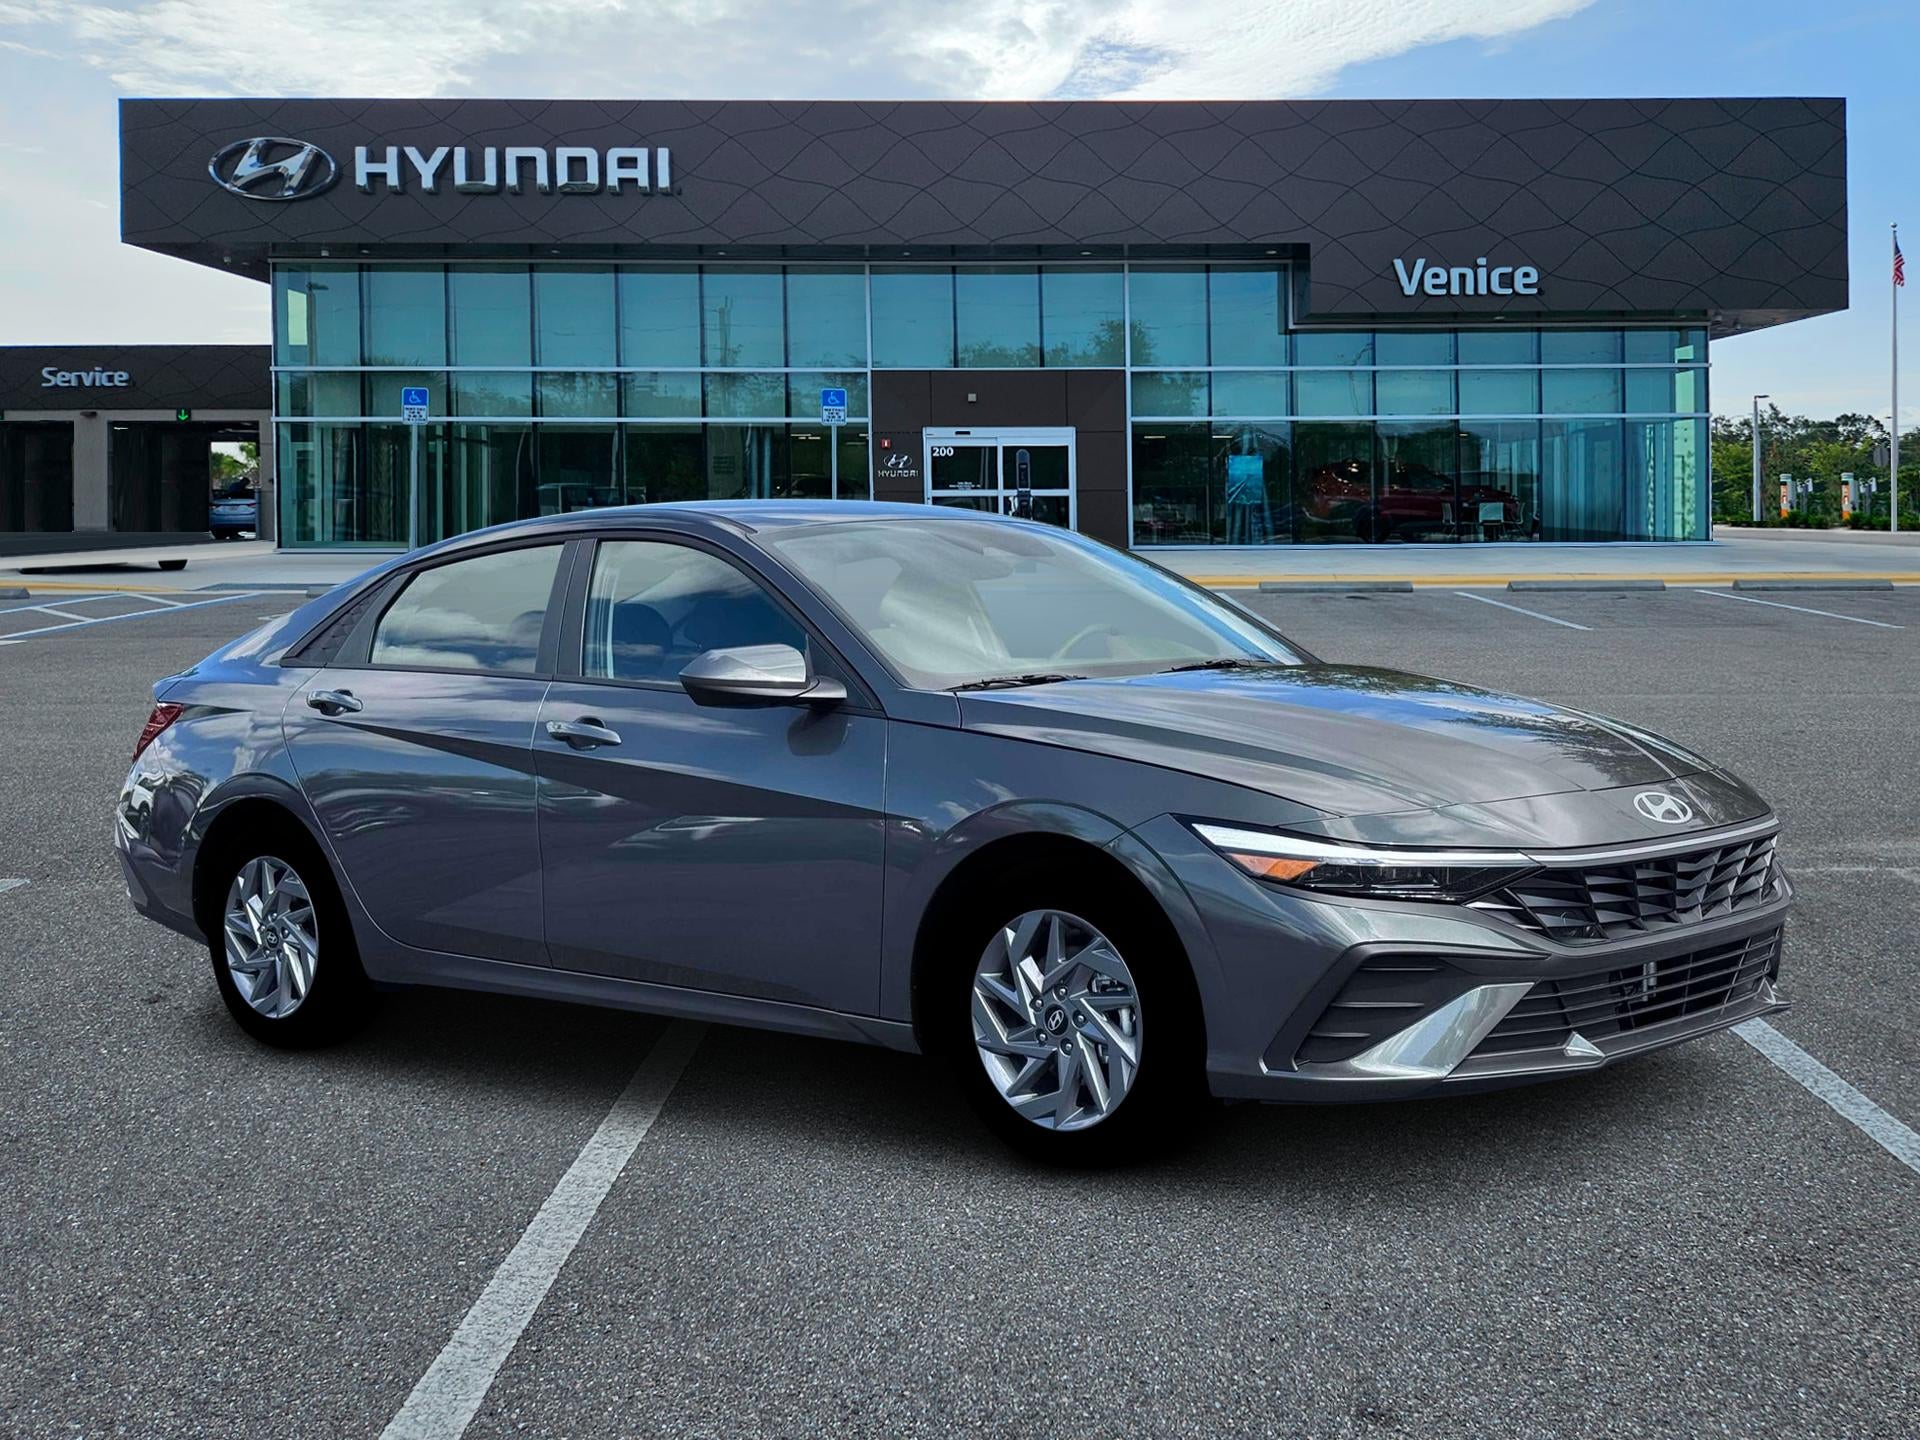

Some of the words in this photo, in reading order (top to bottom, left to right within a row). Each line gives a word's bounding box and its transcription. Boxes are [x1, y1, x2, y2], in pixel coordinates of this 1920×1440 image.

[354, 146, 674, 194] HYUNDAI
[1392, 257, 1539, 296] Venice
[41, 367, 129, 388] Service
[932, 446, 954, 457] 200
[878, 470, 919, 478] HYUNDAI
